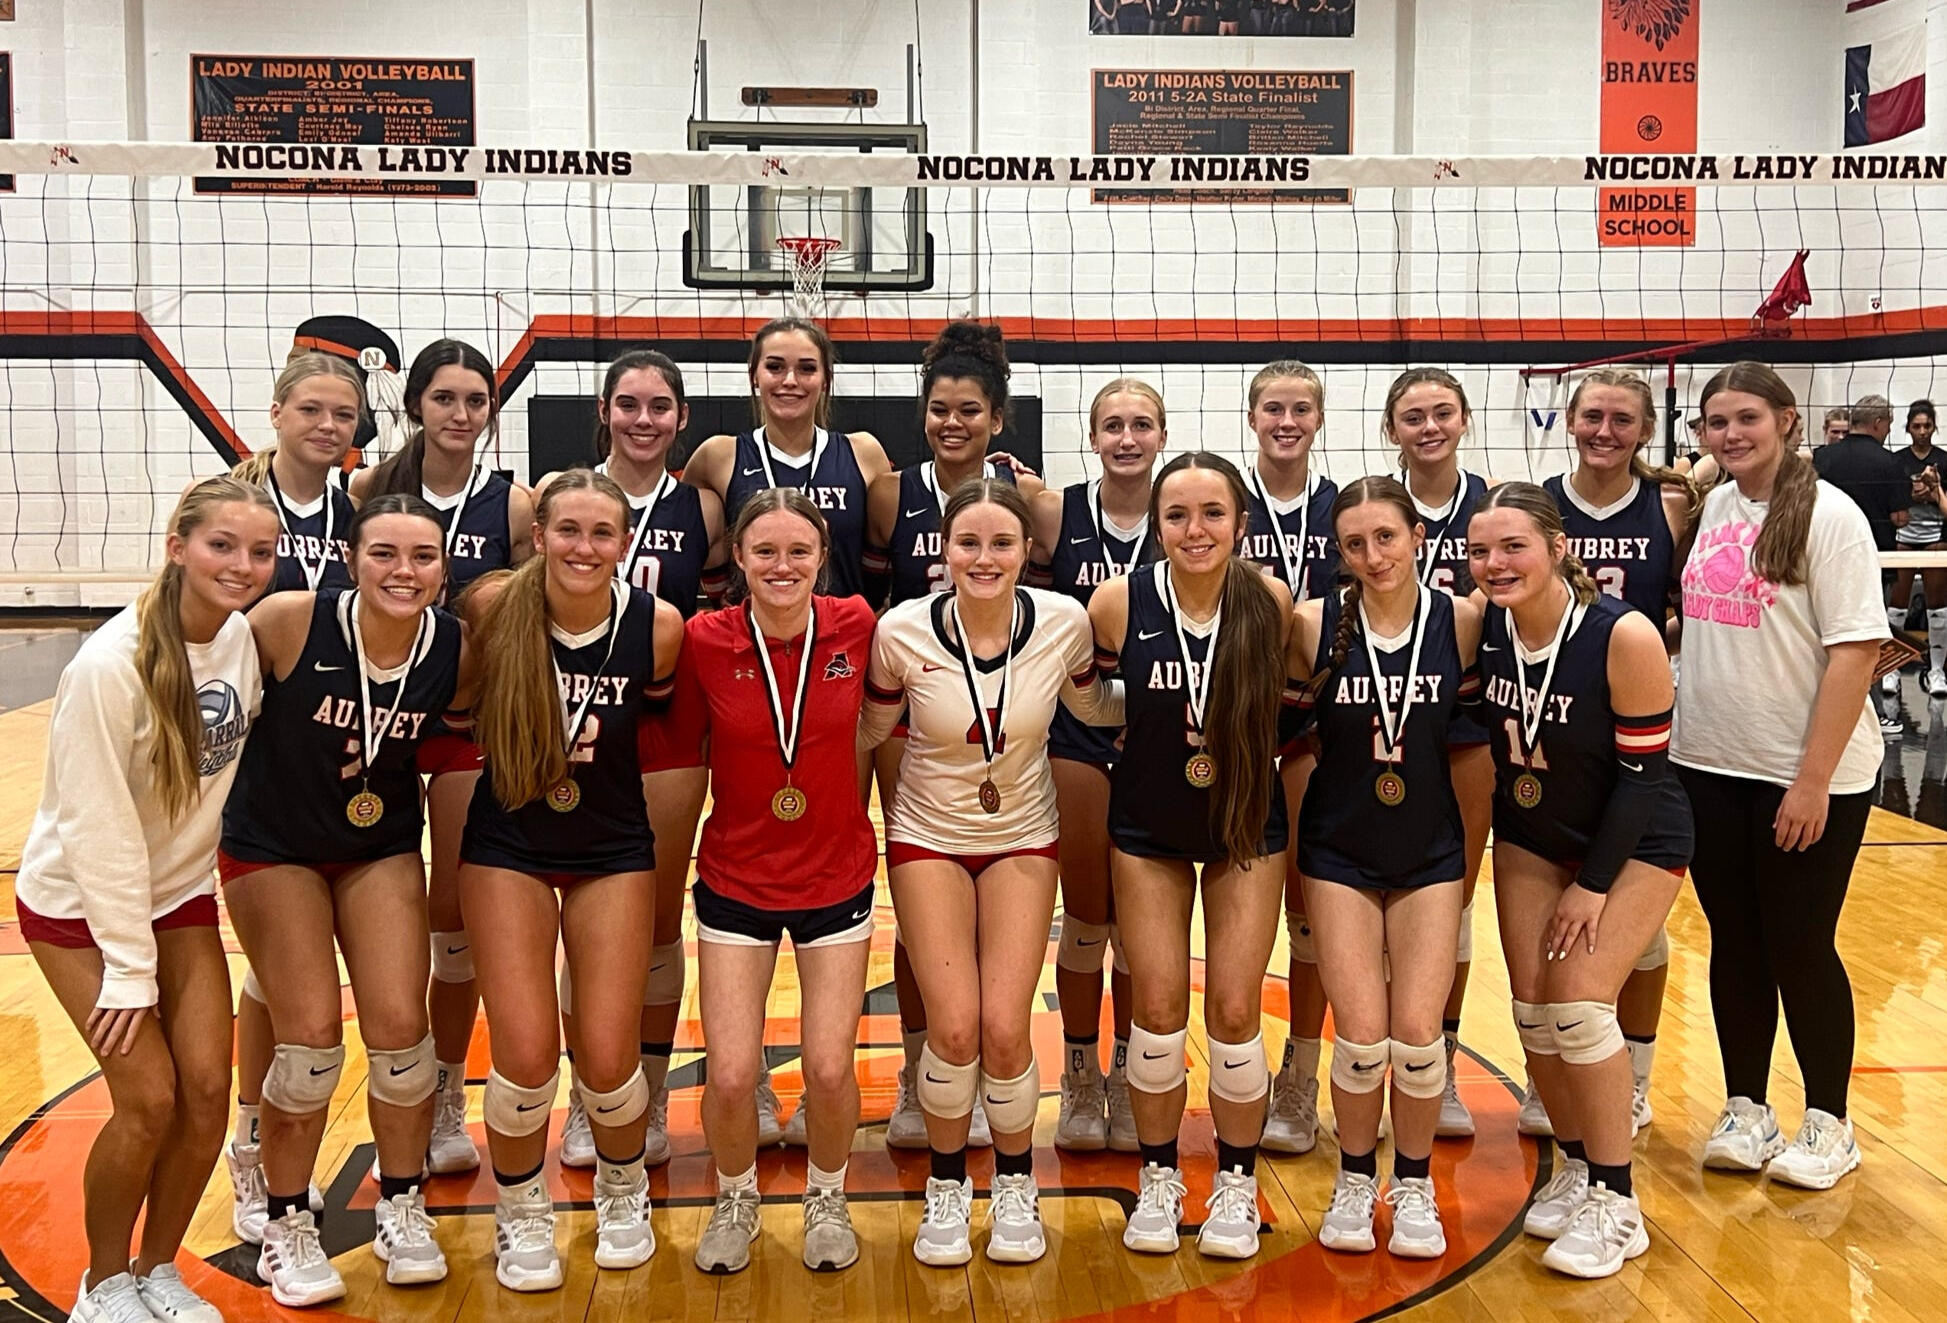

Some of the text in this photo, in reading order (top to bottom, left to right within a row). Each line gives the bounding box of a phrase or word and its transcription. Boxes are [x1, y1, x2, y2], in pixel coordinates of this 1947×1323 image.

[199, 61, 466, 81] LADY INDIAN VOLLEYBALL
[1103, 73, 1341, 89] LADY INDIANS VOLLEYBALL
[1605, 62, 1697, 83] BRAVES
[305, 80, 363, 90] 2001
[1128, 91, 1318, 103] 2011 5-2A State Finalist
[235, 103, 434, 115] STATE SEMI-FINALS
[215, 144, 633, 175] NOCONA LADY INDIANS
[917, 155, 1311, 182] NOCONA LADY INDIANS
[1584, 155, 1947, 180] NOCONA LADY INDIAN
[1609, 194, 1687, 212] MIDDLE
[1604, 218, 1691, 237] SCHOOL
[277, 533, 351, 564] UBREY
[1566, 537, 1650, 560] UBREY
[1682, 591, 1761, 629] ADY CHAPS
[561, 672, 630, 706] BREY
